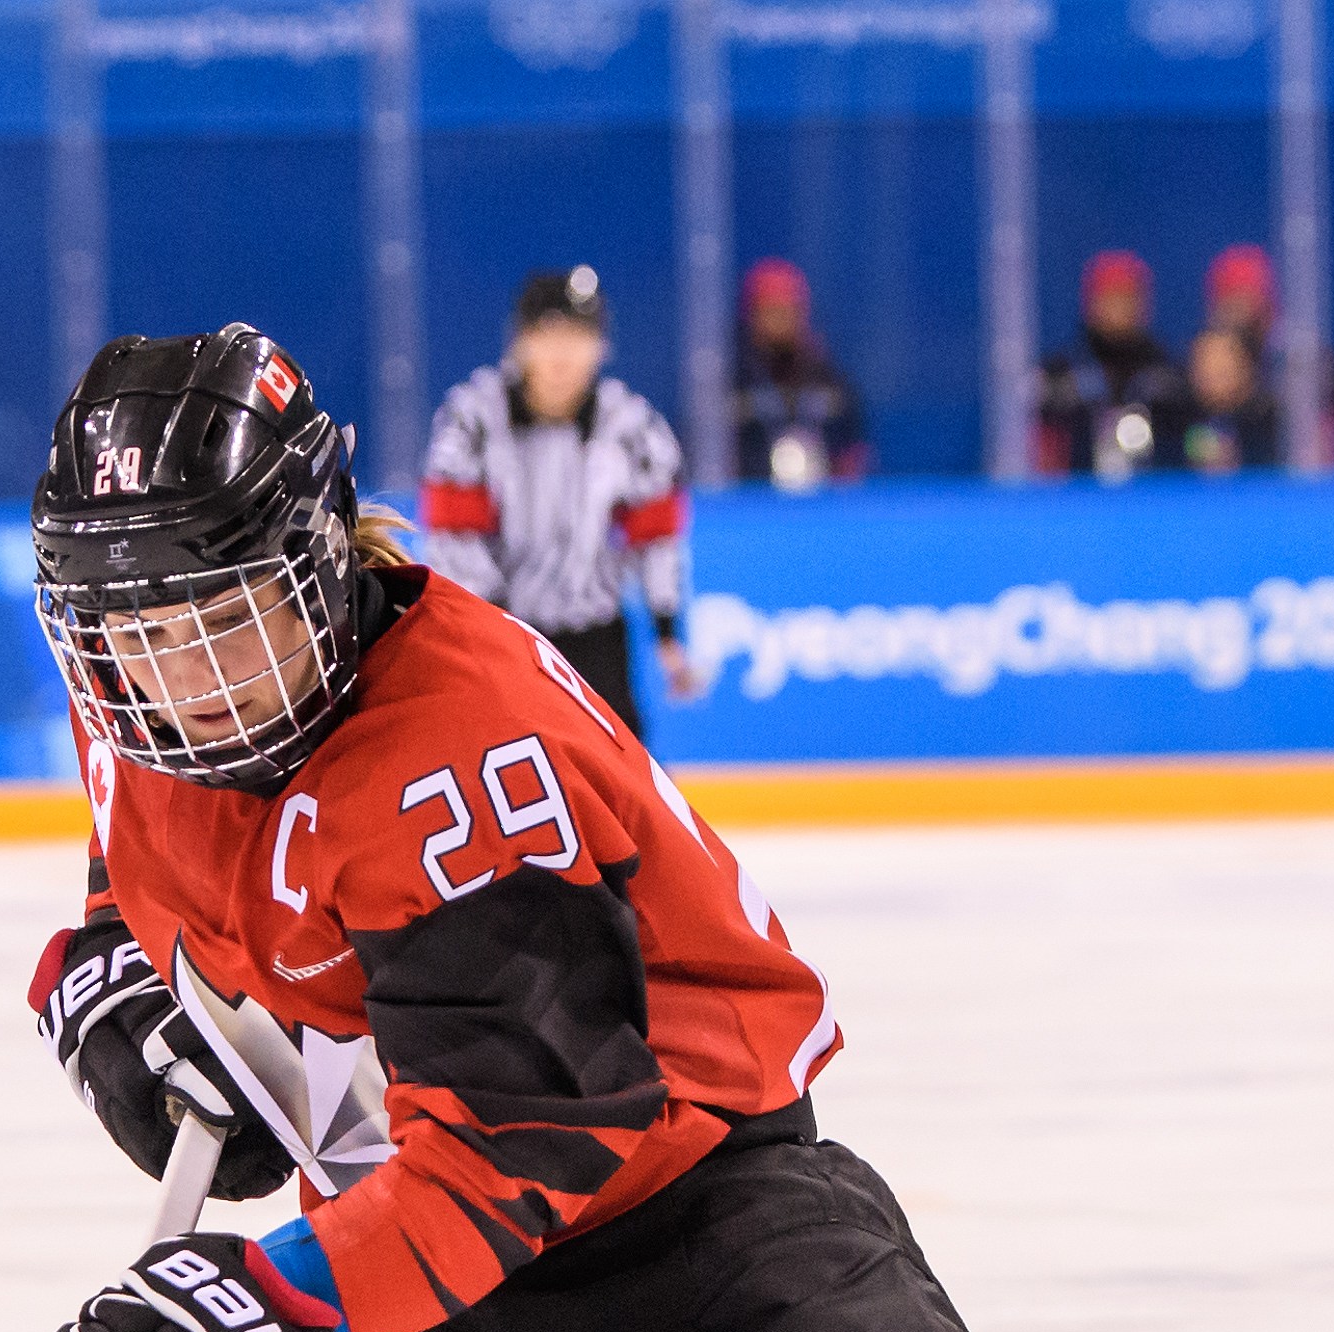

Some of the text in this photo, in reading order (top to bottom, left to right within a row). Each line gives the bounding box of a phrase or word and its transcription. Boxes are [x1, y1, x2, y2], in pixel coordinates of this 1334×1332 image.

[93, 446, 142, 496] 29
[272, 792, 318, 915] C
[399, 734, 581, 901] 29
